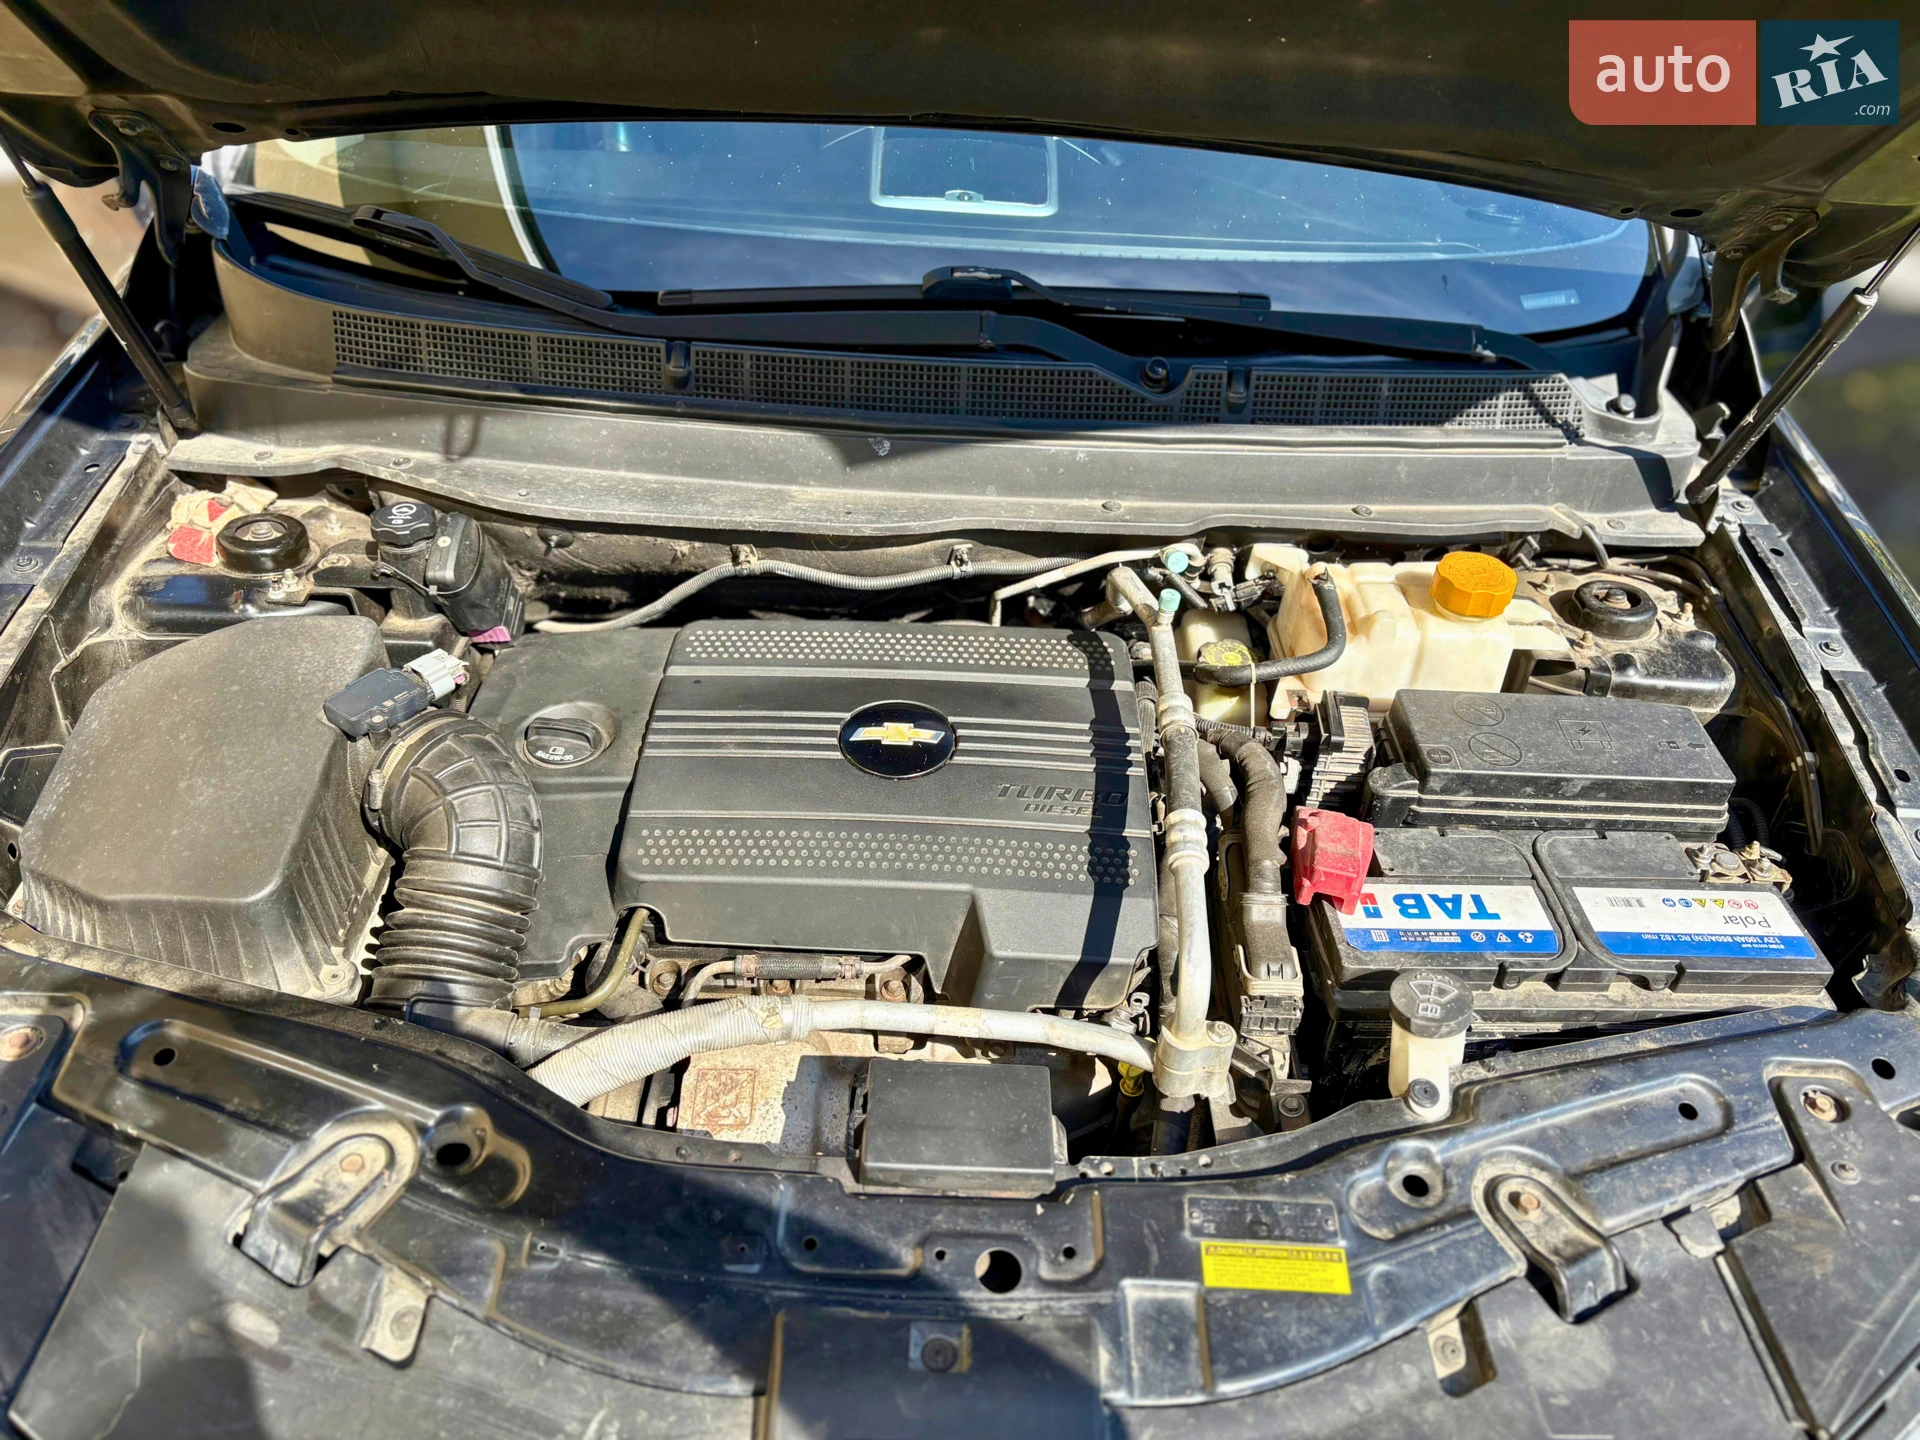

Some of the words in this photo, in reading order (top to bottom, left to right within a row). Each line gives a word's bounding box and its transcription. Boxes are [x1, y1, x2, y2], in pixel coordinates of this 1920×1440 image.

[997, 783, 1129, 807] TURBO
[1023, 802, 1103, 818] DIESEL
[1392, 893, 1502, 920] TAB
[1723, 915, 1771, 928] Polar
[1733, 935, 1762, 943] 100Ah
